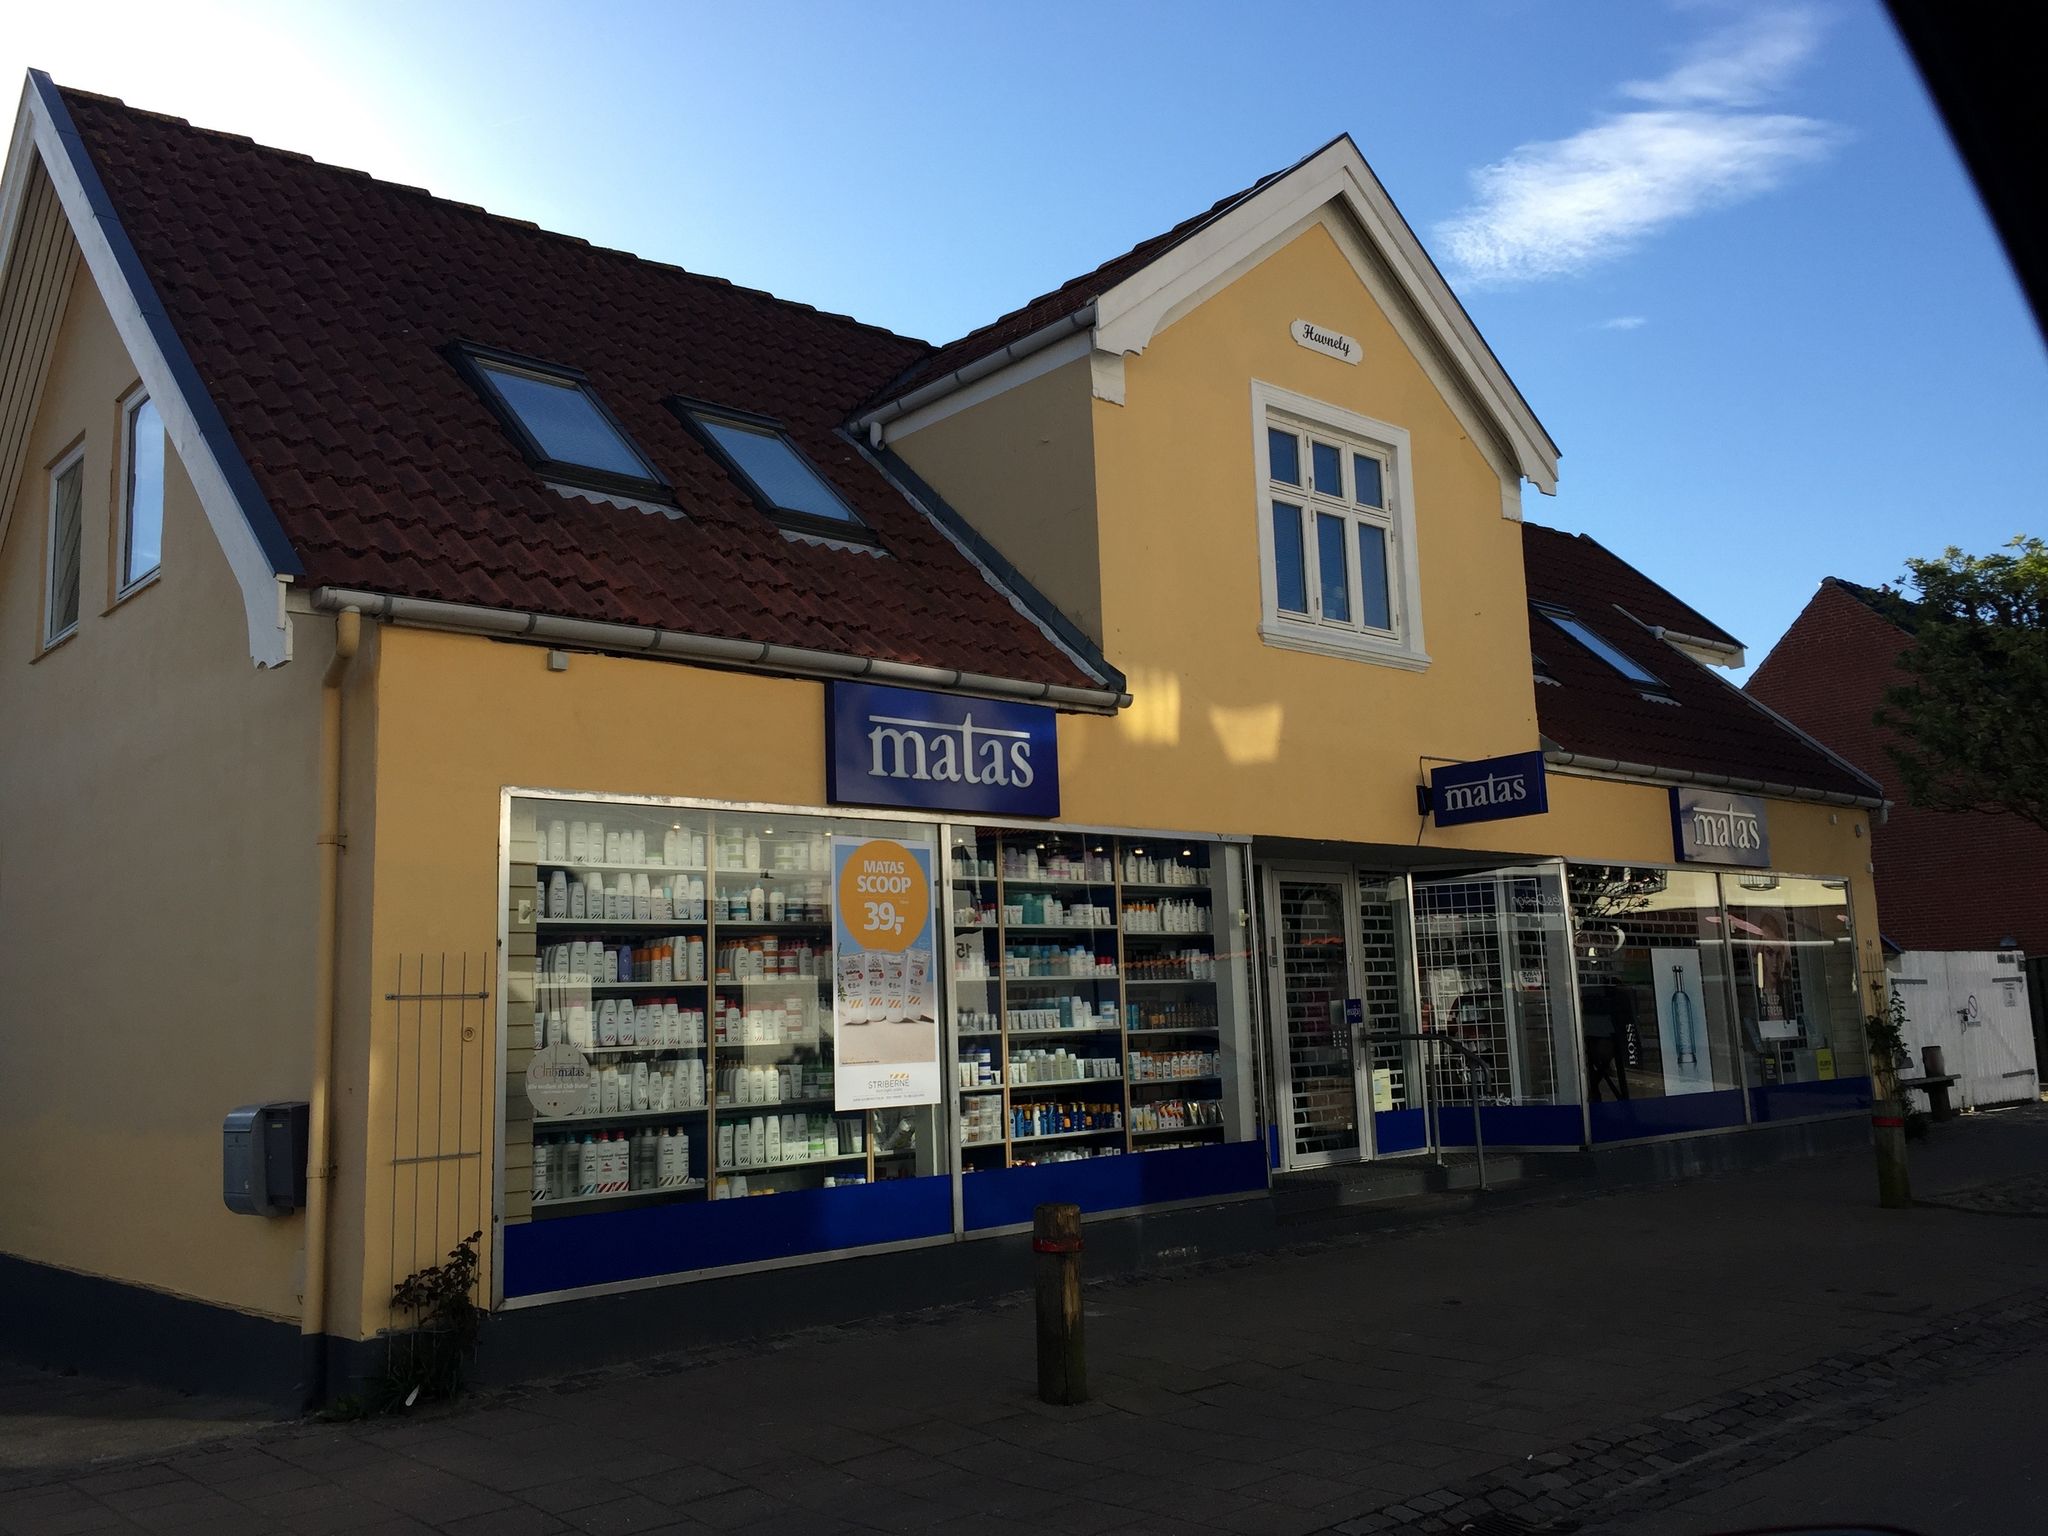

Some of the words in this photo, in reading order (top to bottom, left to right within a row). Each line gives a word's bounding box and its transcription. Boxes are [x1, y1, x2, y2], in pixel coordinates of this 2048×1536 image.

[1302, 323, 1350, 357] Havnely
[868, 712, 1035, 788] matas
[1444, 773, 1527, 811] matas
[1693, 803, 1761, 849] matas
[857, 875, 912, 894] SCOOP
[863, 860, 905, 875] MATAS
[1626, 1023, 1637, 1065] BOSS
[868, 1079, 910, 1090] STRIBERNE
